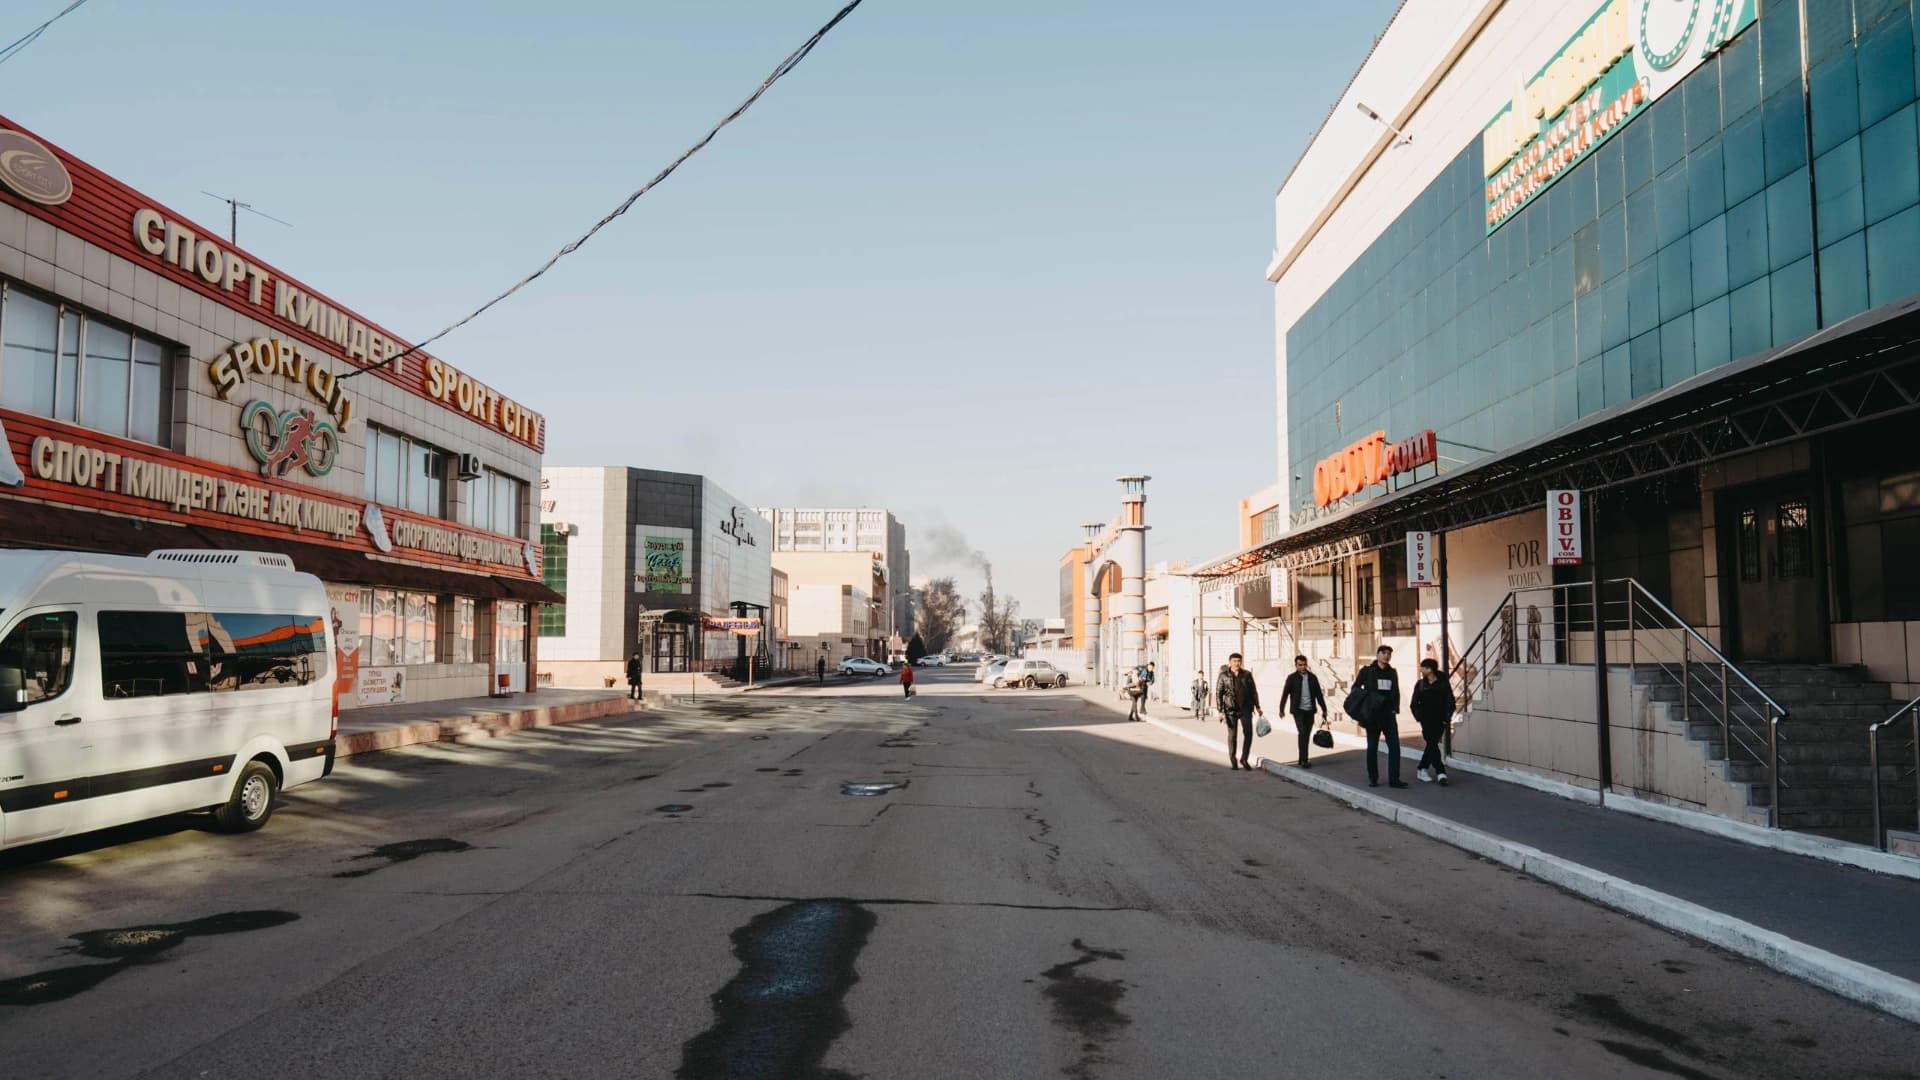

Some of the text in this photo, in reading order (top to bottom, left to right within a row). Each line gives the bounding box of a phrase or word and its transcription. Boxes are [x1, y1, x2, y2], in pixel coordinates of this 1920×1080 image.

[134, 208, 268, 305] СПОРТ
[209, 337, 309, 400] SPORT
[425, 357, 542, 446] SPORT CITY
[31, 436, 122, 492] СПОРТ
[393, 519, 459, 556] СПОРТИВНАЯ
[1416, 533, 1424, 581] ОБУВЬ
[1507, 539, 1541, 570] FOR
[1507, 570, 1542, 587] WOMEN
